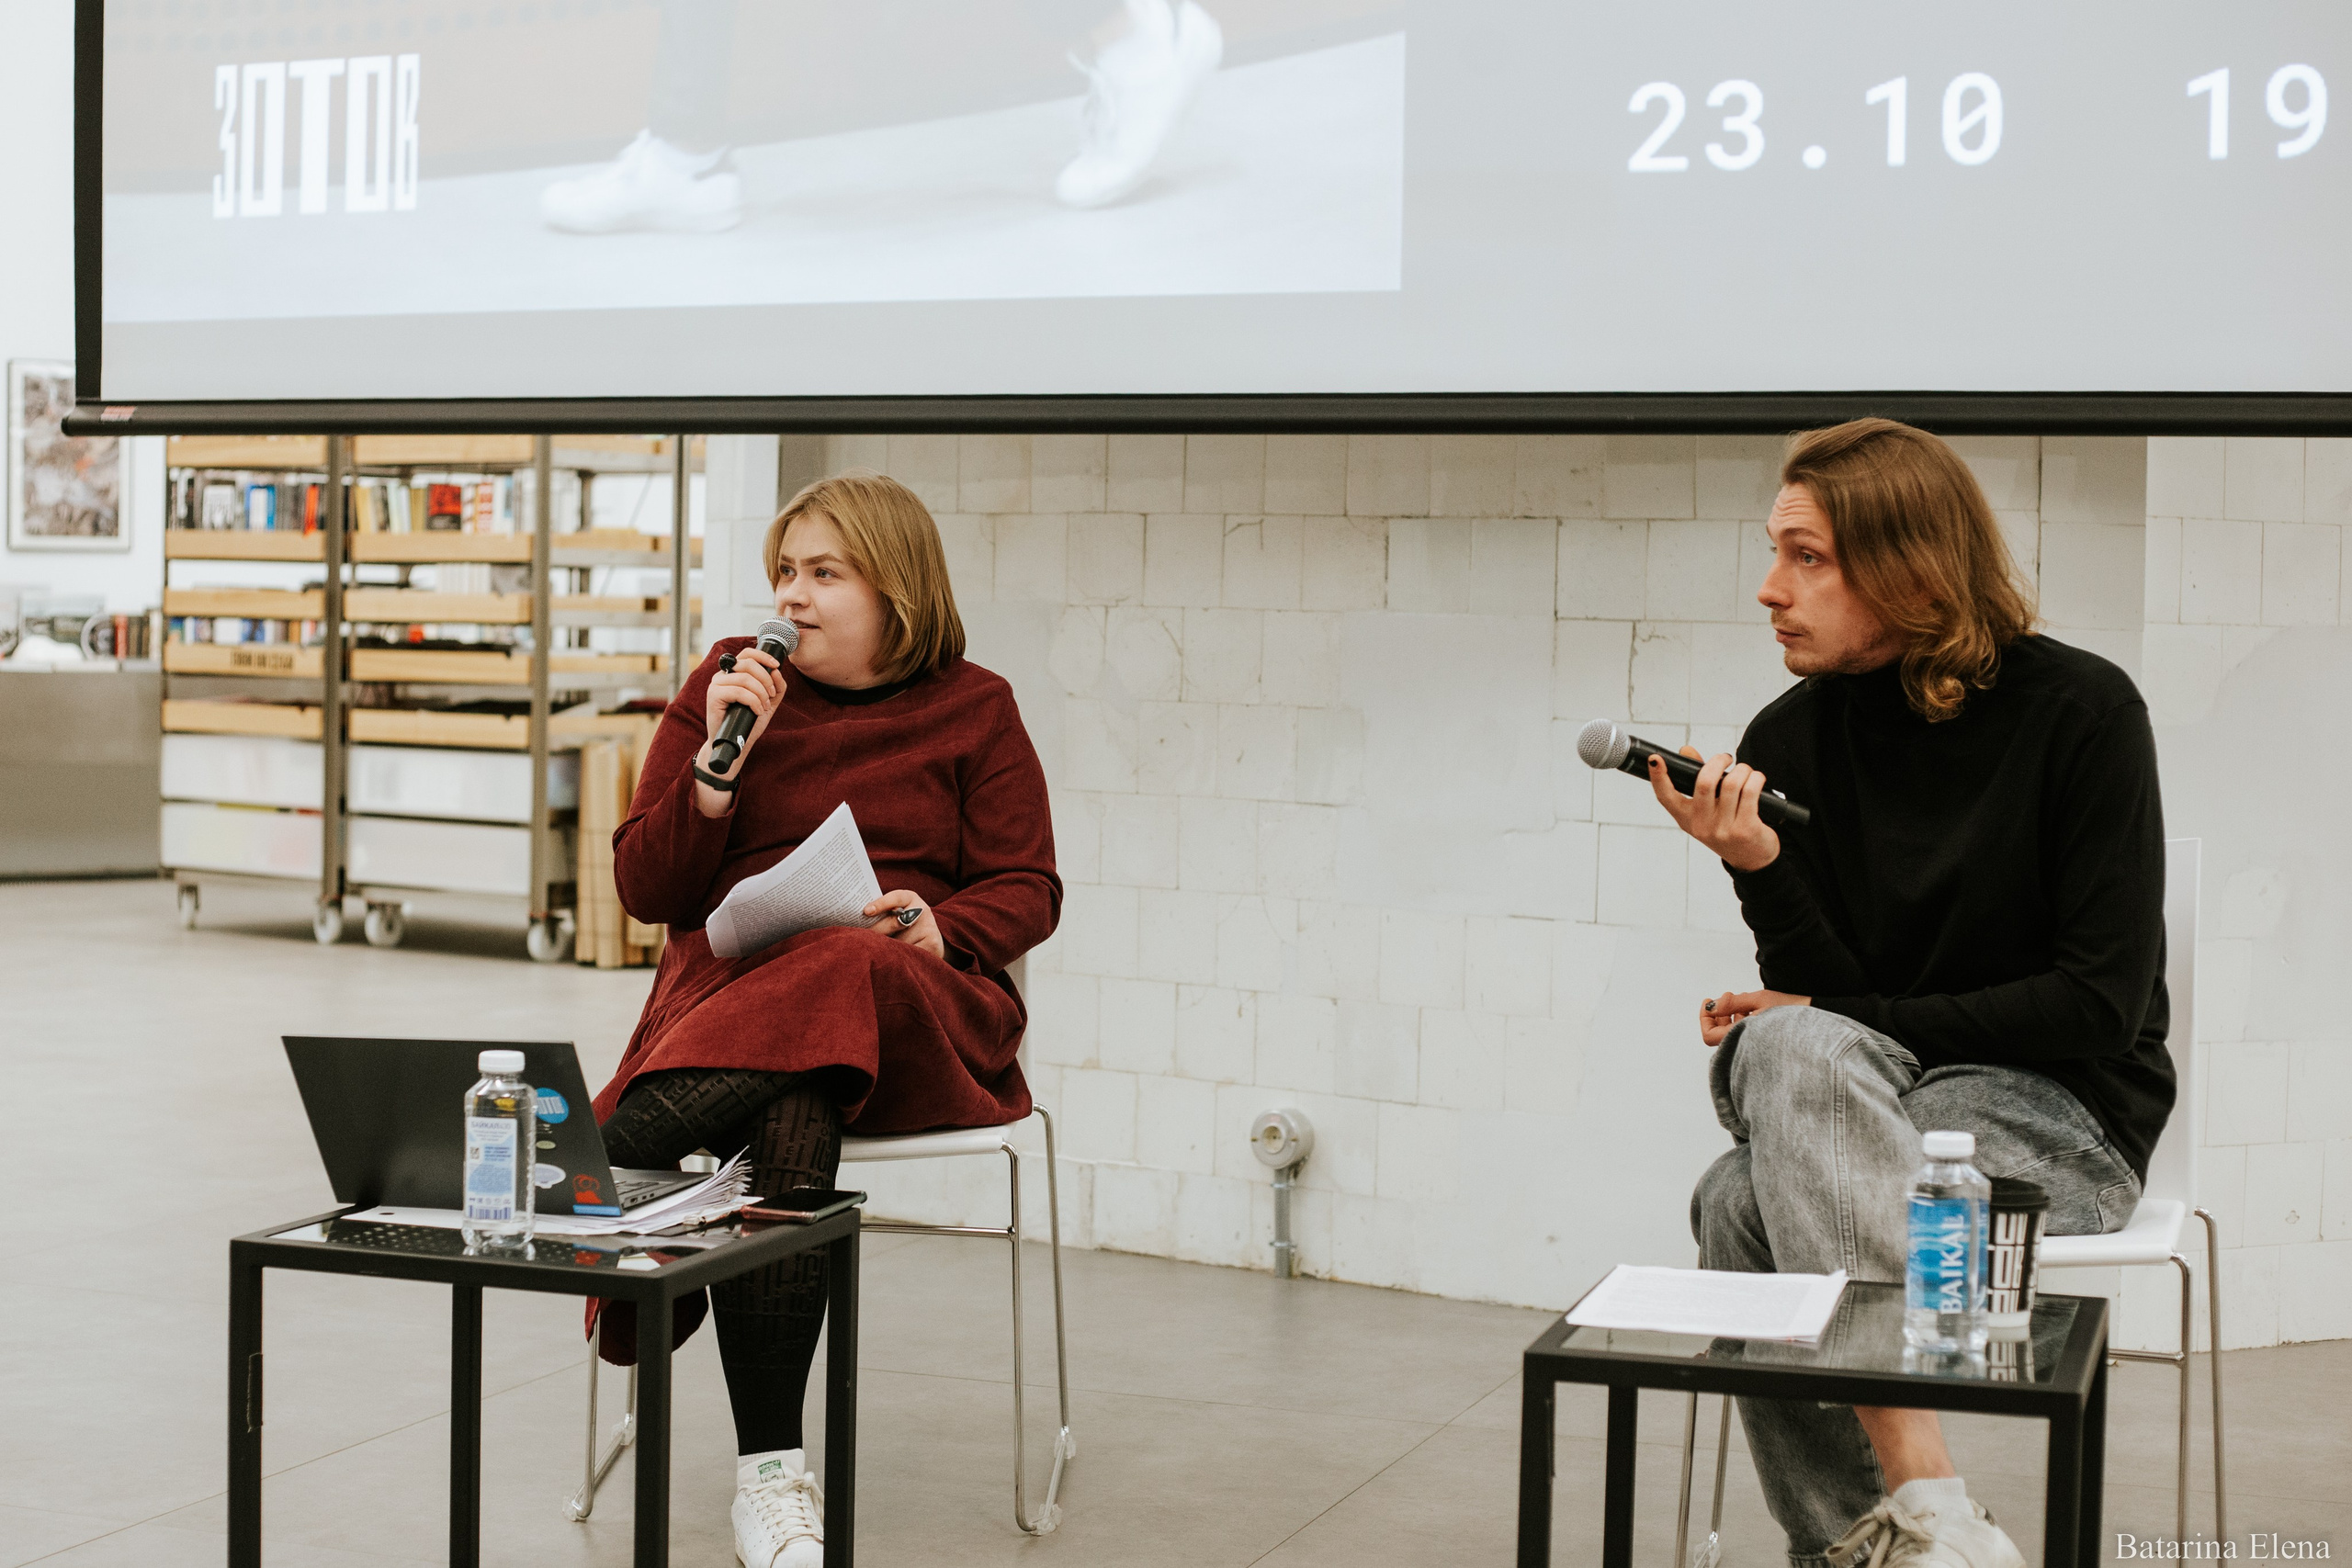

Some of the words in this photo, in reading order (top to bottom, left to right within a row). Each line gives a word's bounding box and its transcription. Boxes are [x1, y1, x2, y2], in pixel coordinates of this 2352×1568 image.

[212, 53, 422, 220] ЗОТОВ
[1626, 72, 2005, 173] 23.10
[2187, 62, 2329, 161] 19
[1939, 1214, 1964, 1314] BAIKAL
